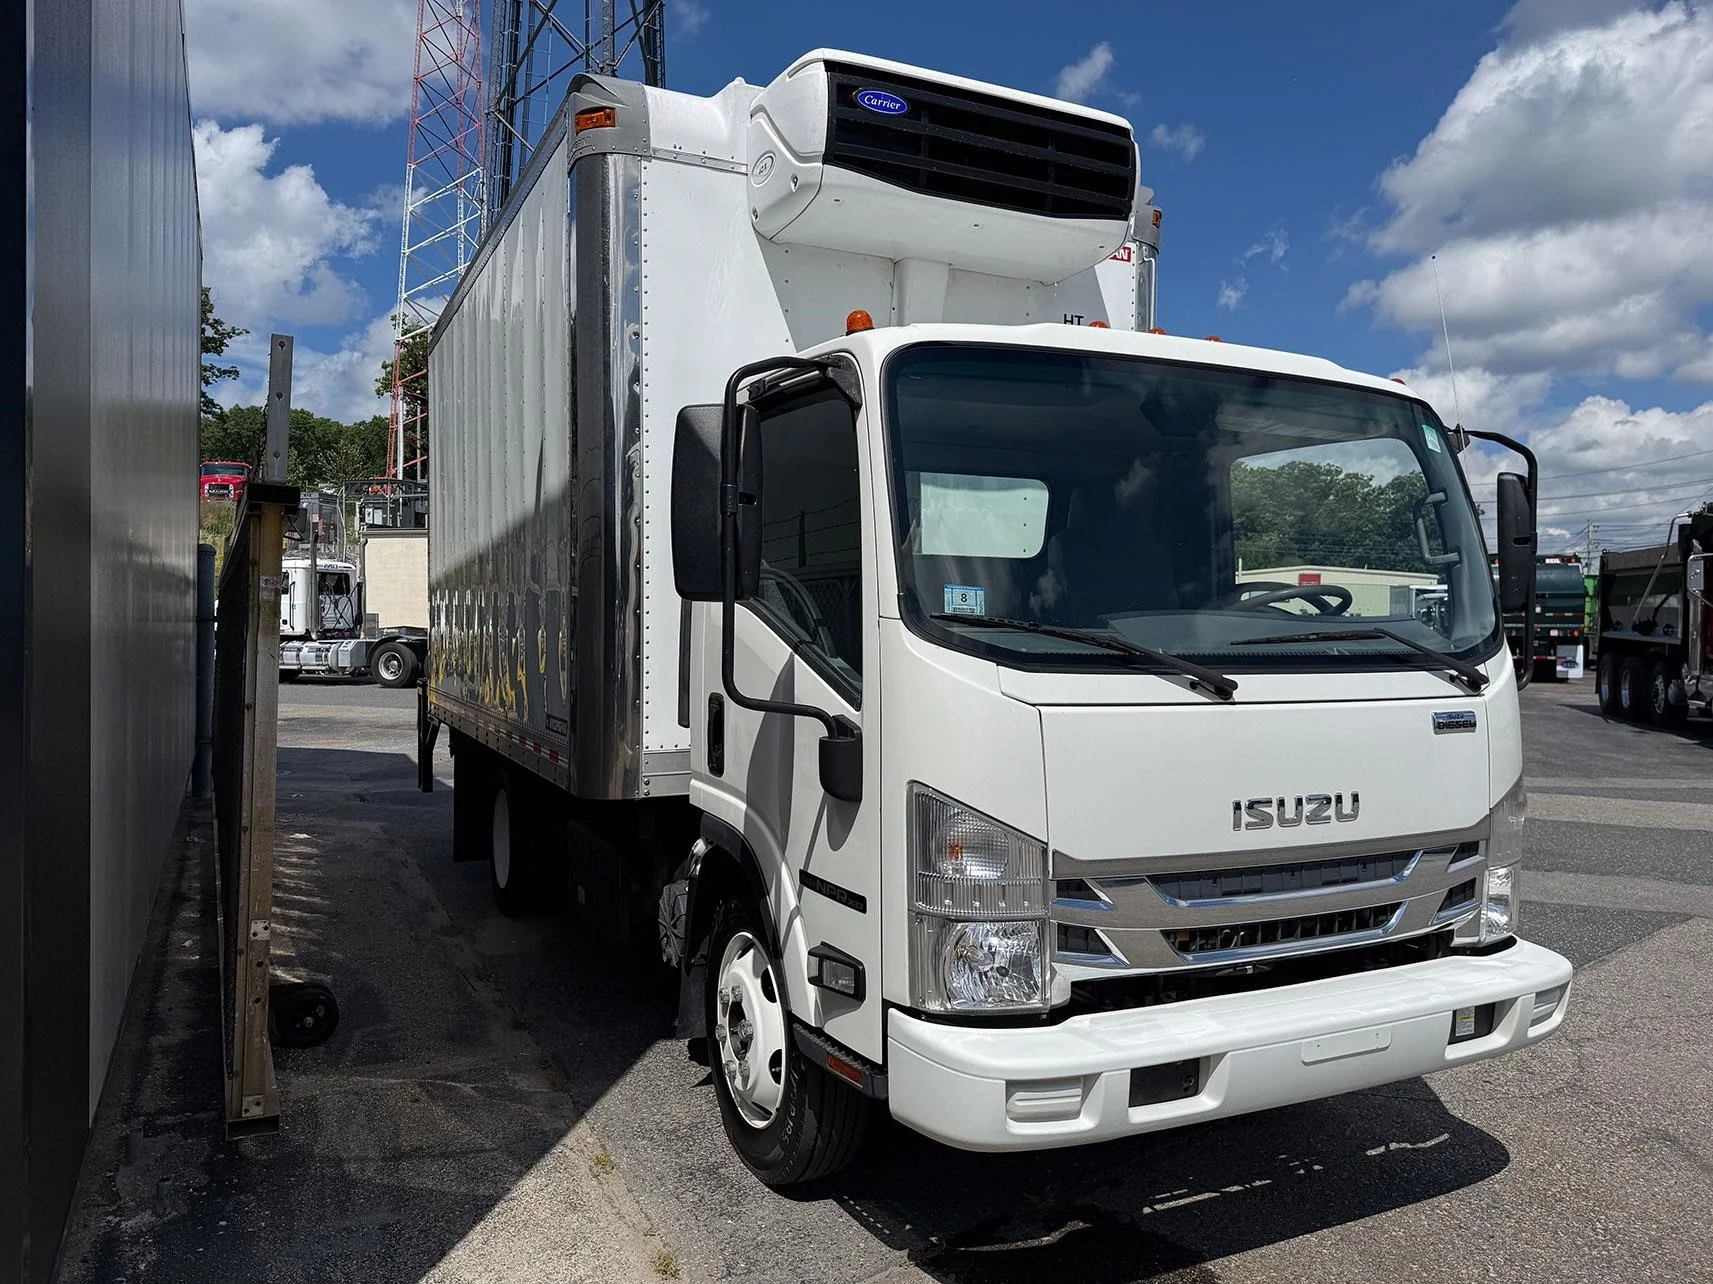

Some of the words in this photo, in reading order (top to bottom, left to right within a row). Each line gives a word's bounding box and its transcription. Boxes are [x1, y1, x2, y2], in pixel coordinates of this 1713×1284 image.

[864, 94, 901, 110] Carrier
[1063, 313, 1084, 326] HT
[960, 592, 968, 603] 8
[1232, 790, 1360, 831] ISUZU
